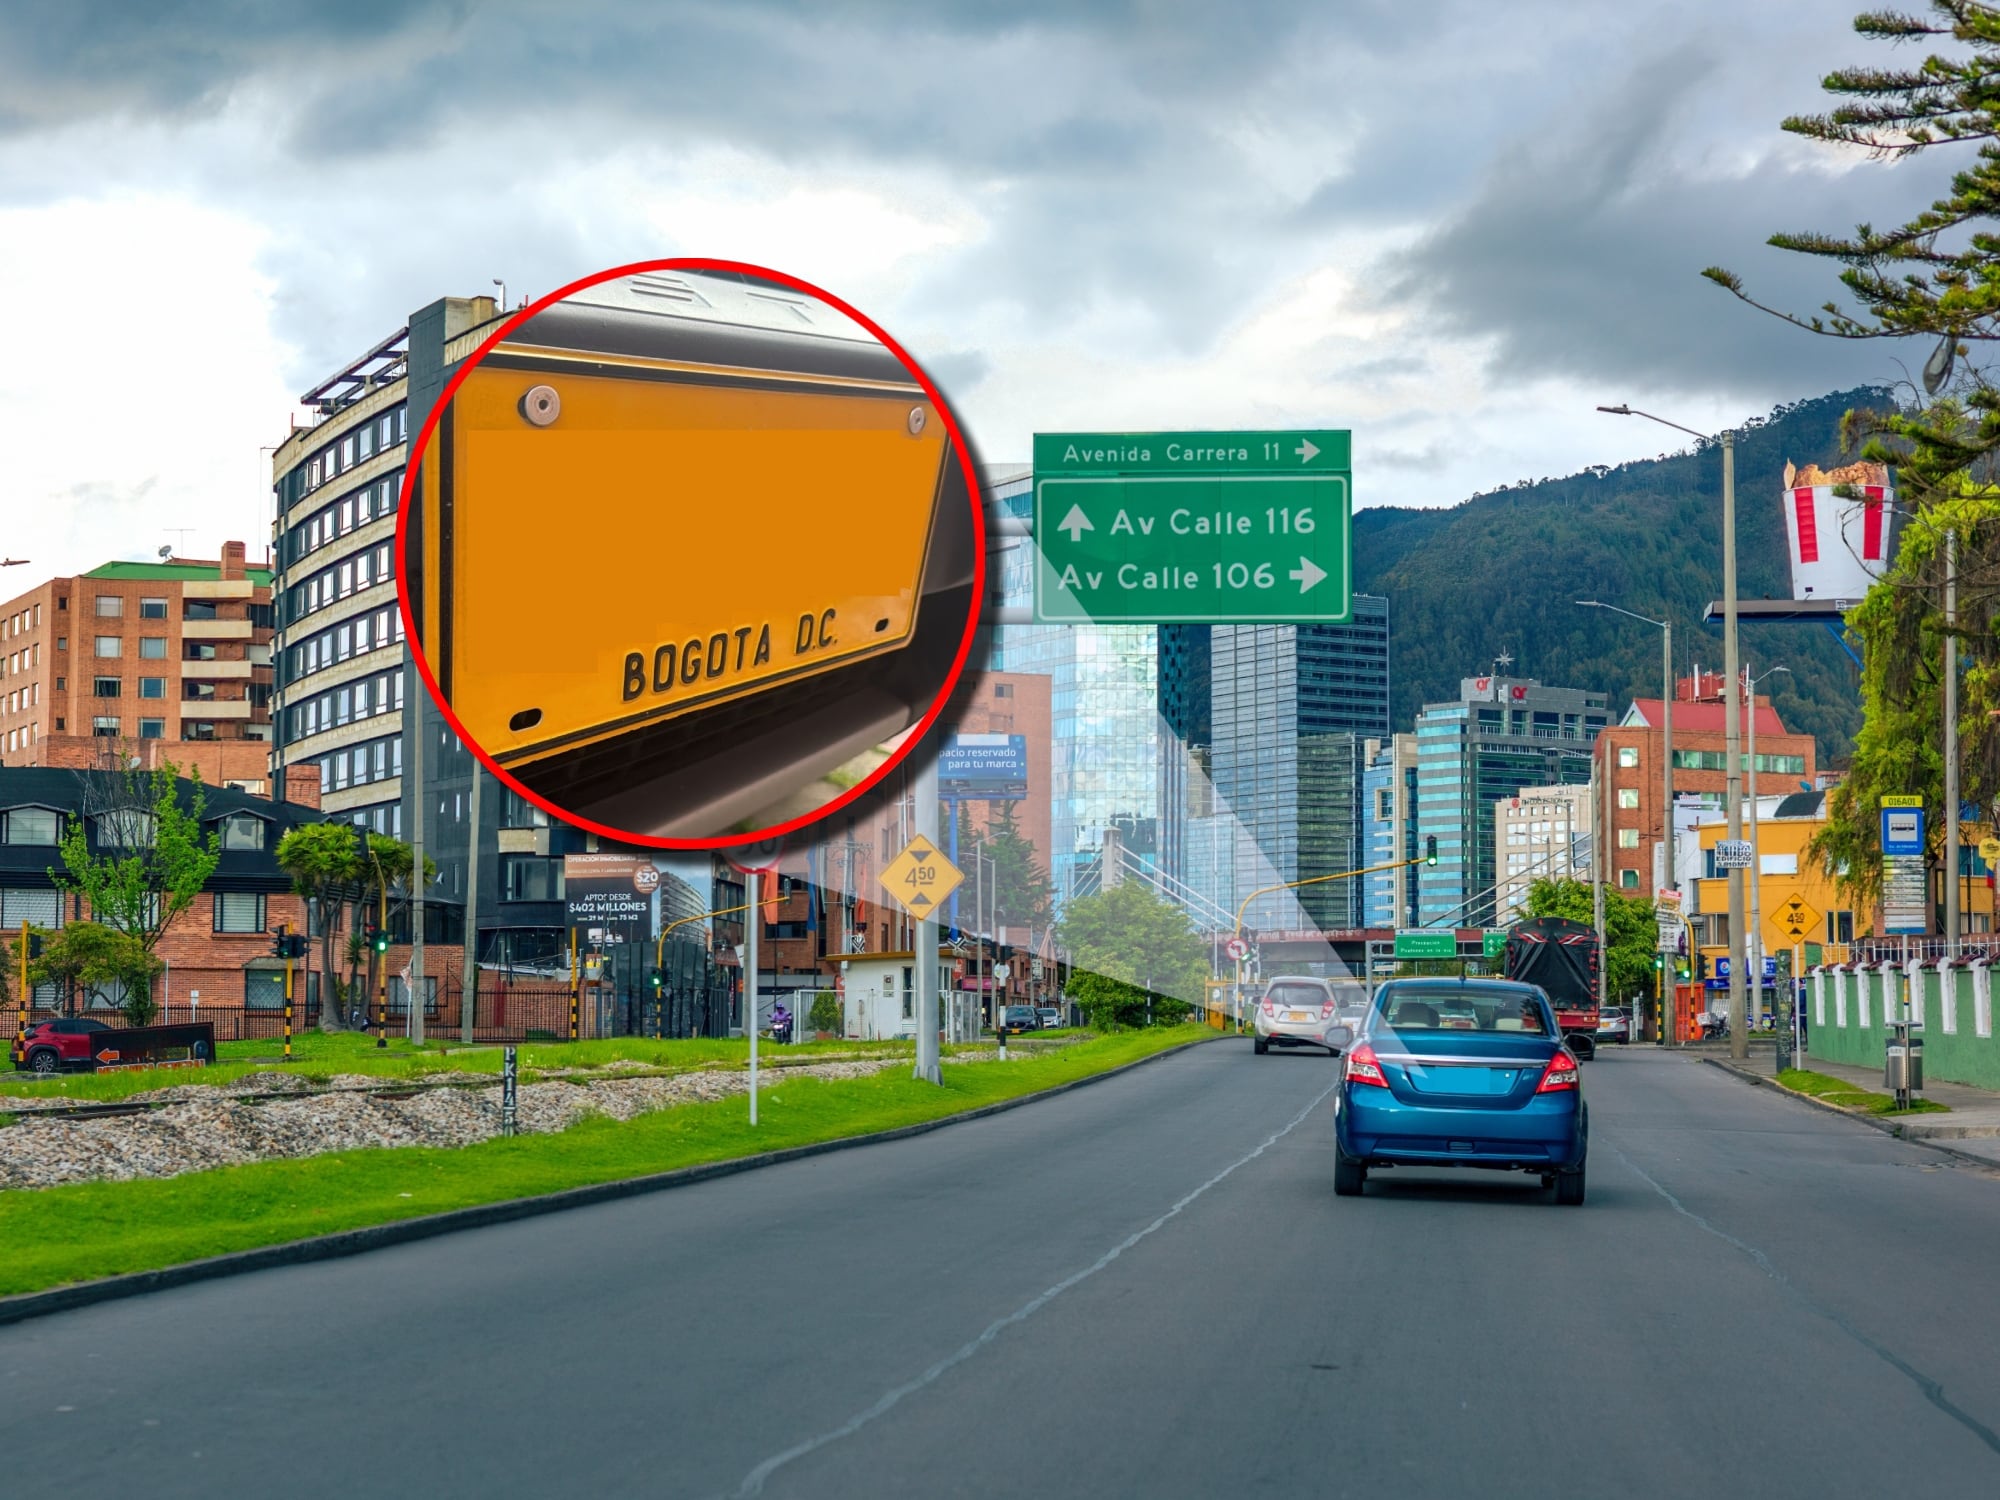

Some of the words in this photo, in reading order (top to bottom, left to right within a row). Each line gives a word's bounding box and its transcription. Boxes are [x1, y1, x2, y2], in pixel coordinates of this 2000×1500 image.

[1063, 444, 1151, 463] Avenida
[1166, 443, 1248, 461] Carrera
[1263, 442, 1280, 460] 11
[1109, 508, 1155, 536] Av
[1169, 508, 1252, 535] Calle
[1265, 507, 1316, 534] 116
[1057, 563, 1103, 590] Av
[1117, 563, 1199, 589] Calle
[1212, 562, 1275, 589] 106
[622, 622, 771, 702] BOGOTA
[795, 607, 839, 656] D.C.
[967, 747, 1017, 758] reservado
[948, 760, 971, 772] para
[973, 761, 983, 769] tu
[986, 761, 1017, 769] marca
[636, 871, 659, 883] $20
[609, 893, 632, 901] DESDE
[569, 902, 595, 913] $402
[597, 902, 647, 912] MILLONES
